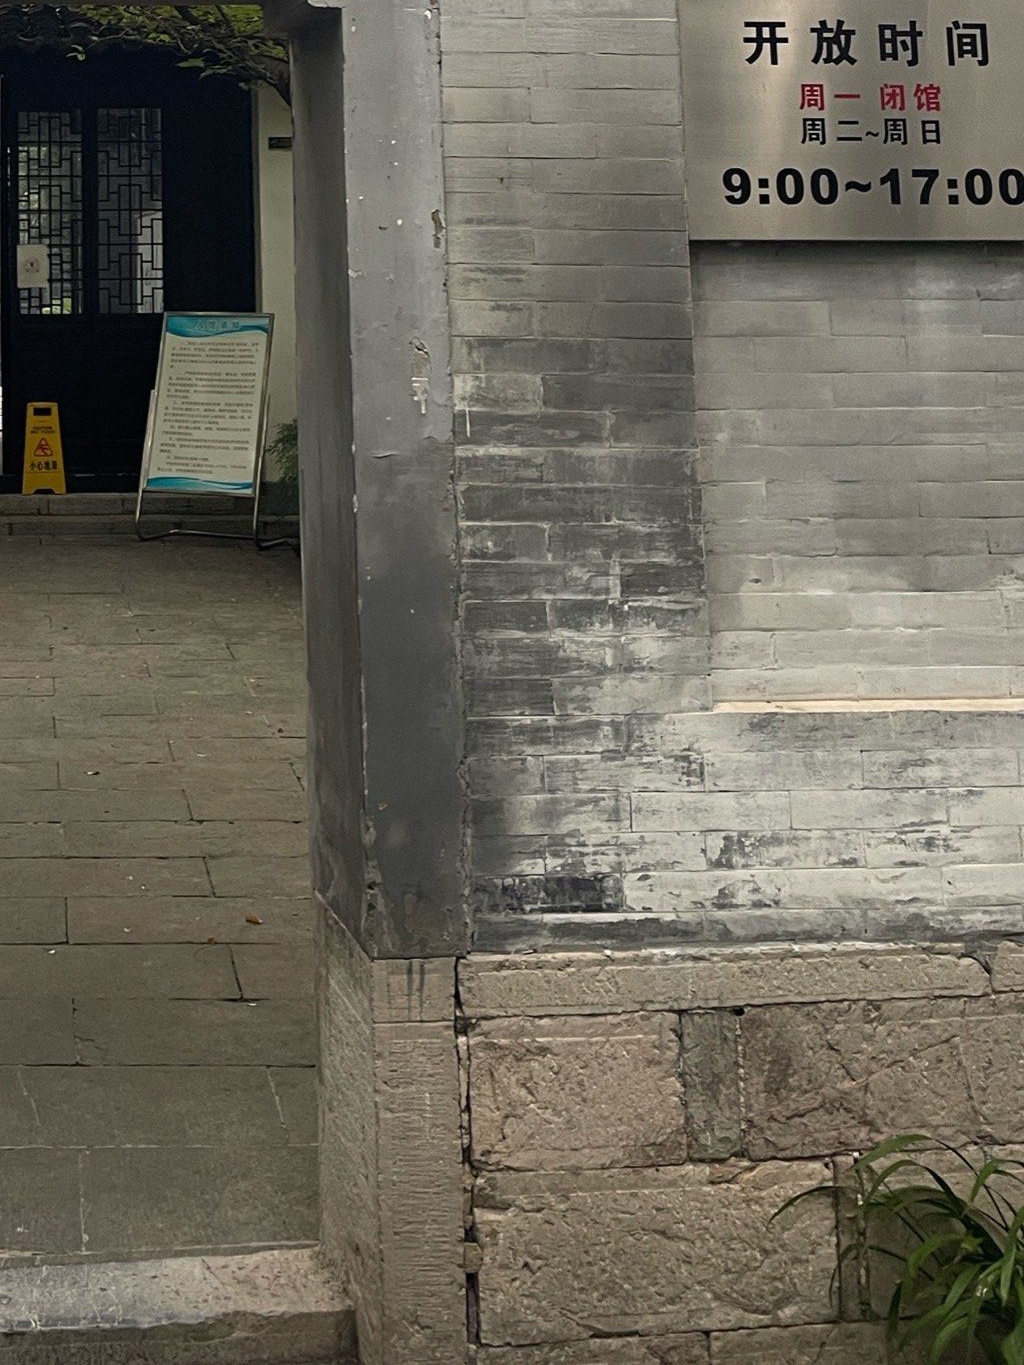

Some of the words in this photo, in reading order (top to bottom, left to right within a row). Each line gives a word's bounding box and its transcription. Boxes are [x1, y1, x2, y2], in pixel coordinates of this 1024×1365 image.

[743, 19, 990, 67] 开放时间
[722, 167, 1024, 206] 9:00~17:00
